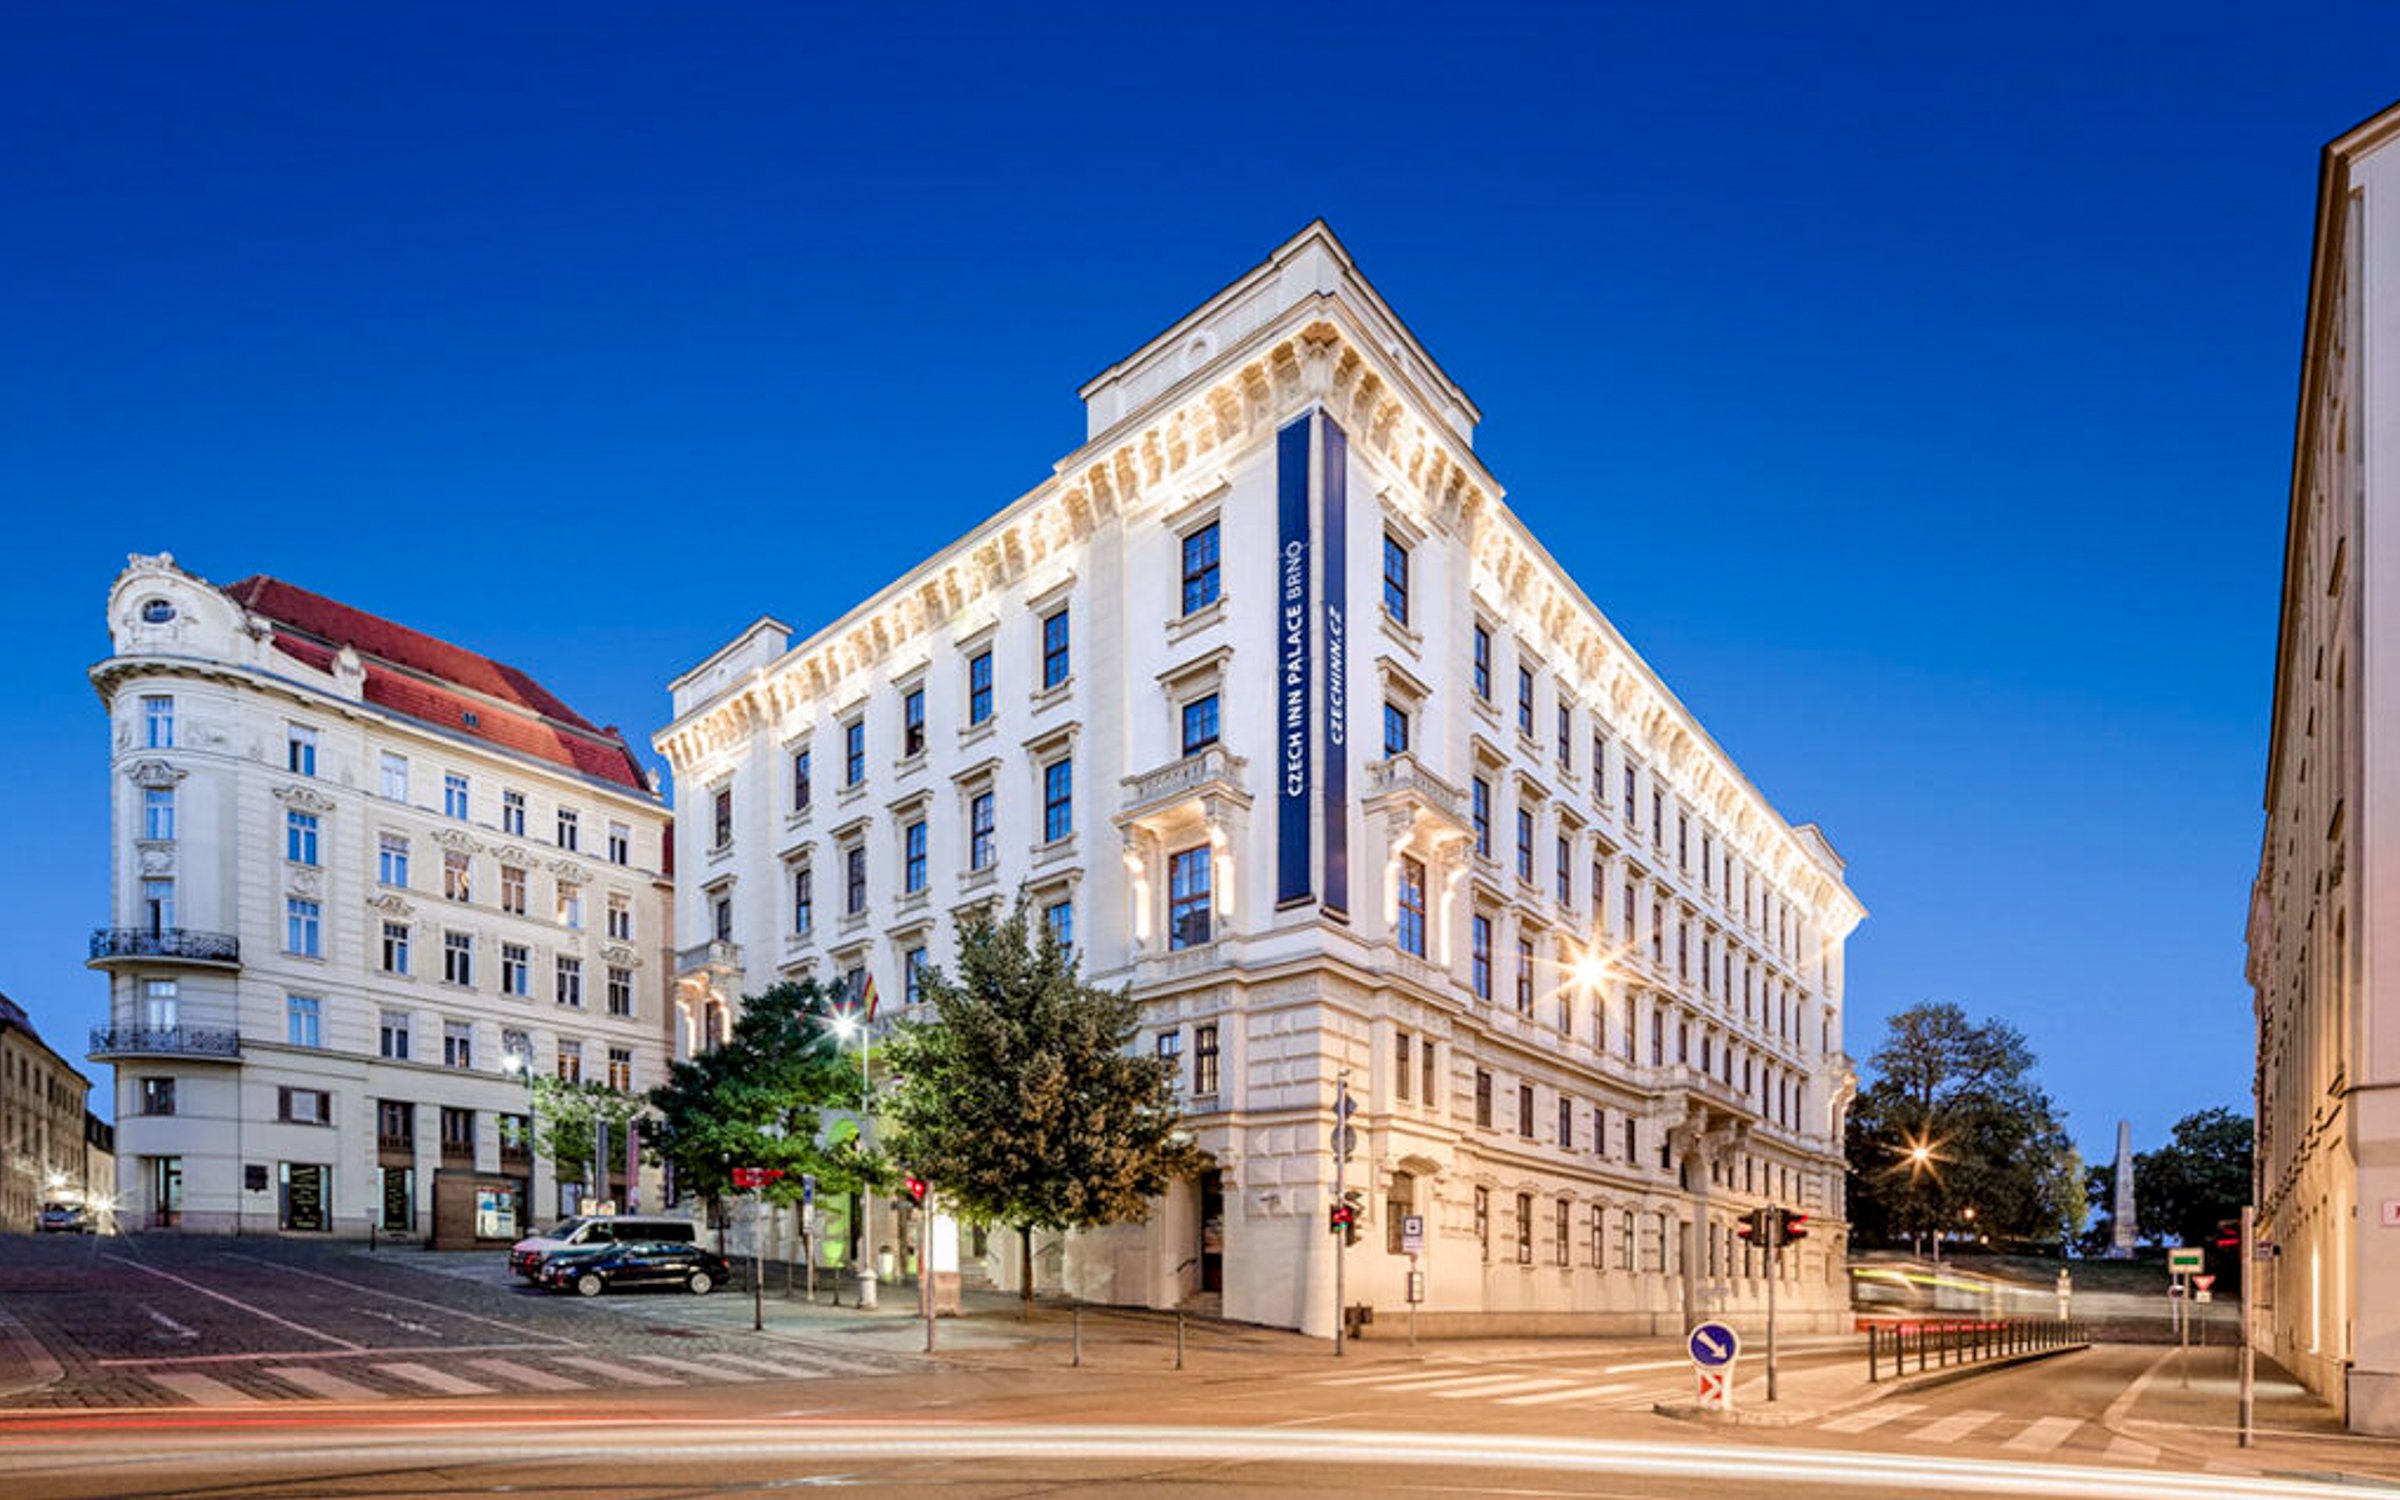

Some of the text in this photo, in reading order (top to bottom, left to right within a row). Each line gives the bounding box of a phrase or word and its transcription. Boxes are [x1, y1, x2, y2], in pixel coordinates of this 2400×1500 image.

[1285, 540, 1303, 797] CZECH INN PALACE BRNO
[1329, 604, 1343, 746] CZECHINN.CZ
